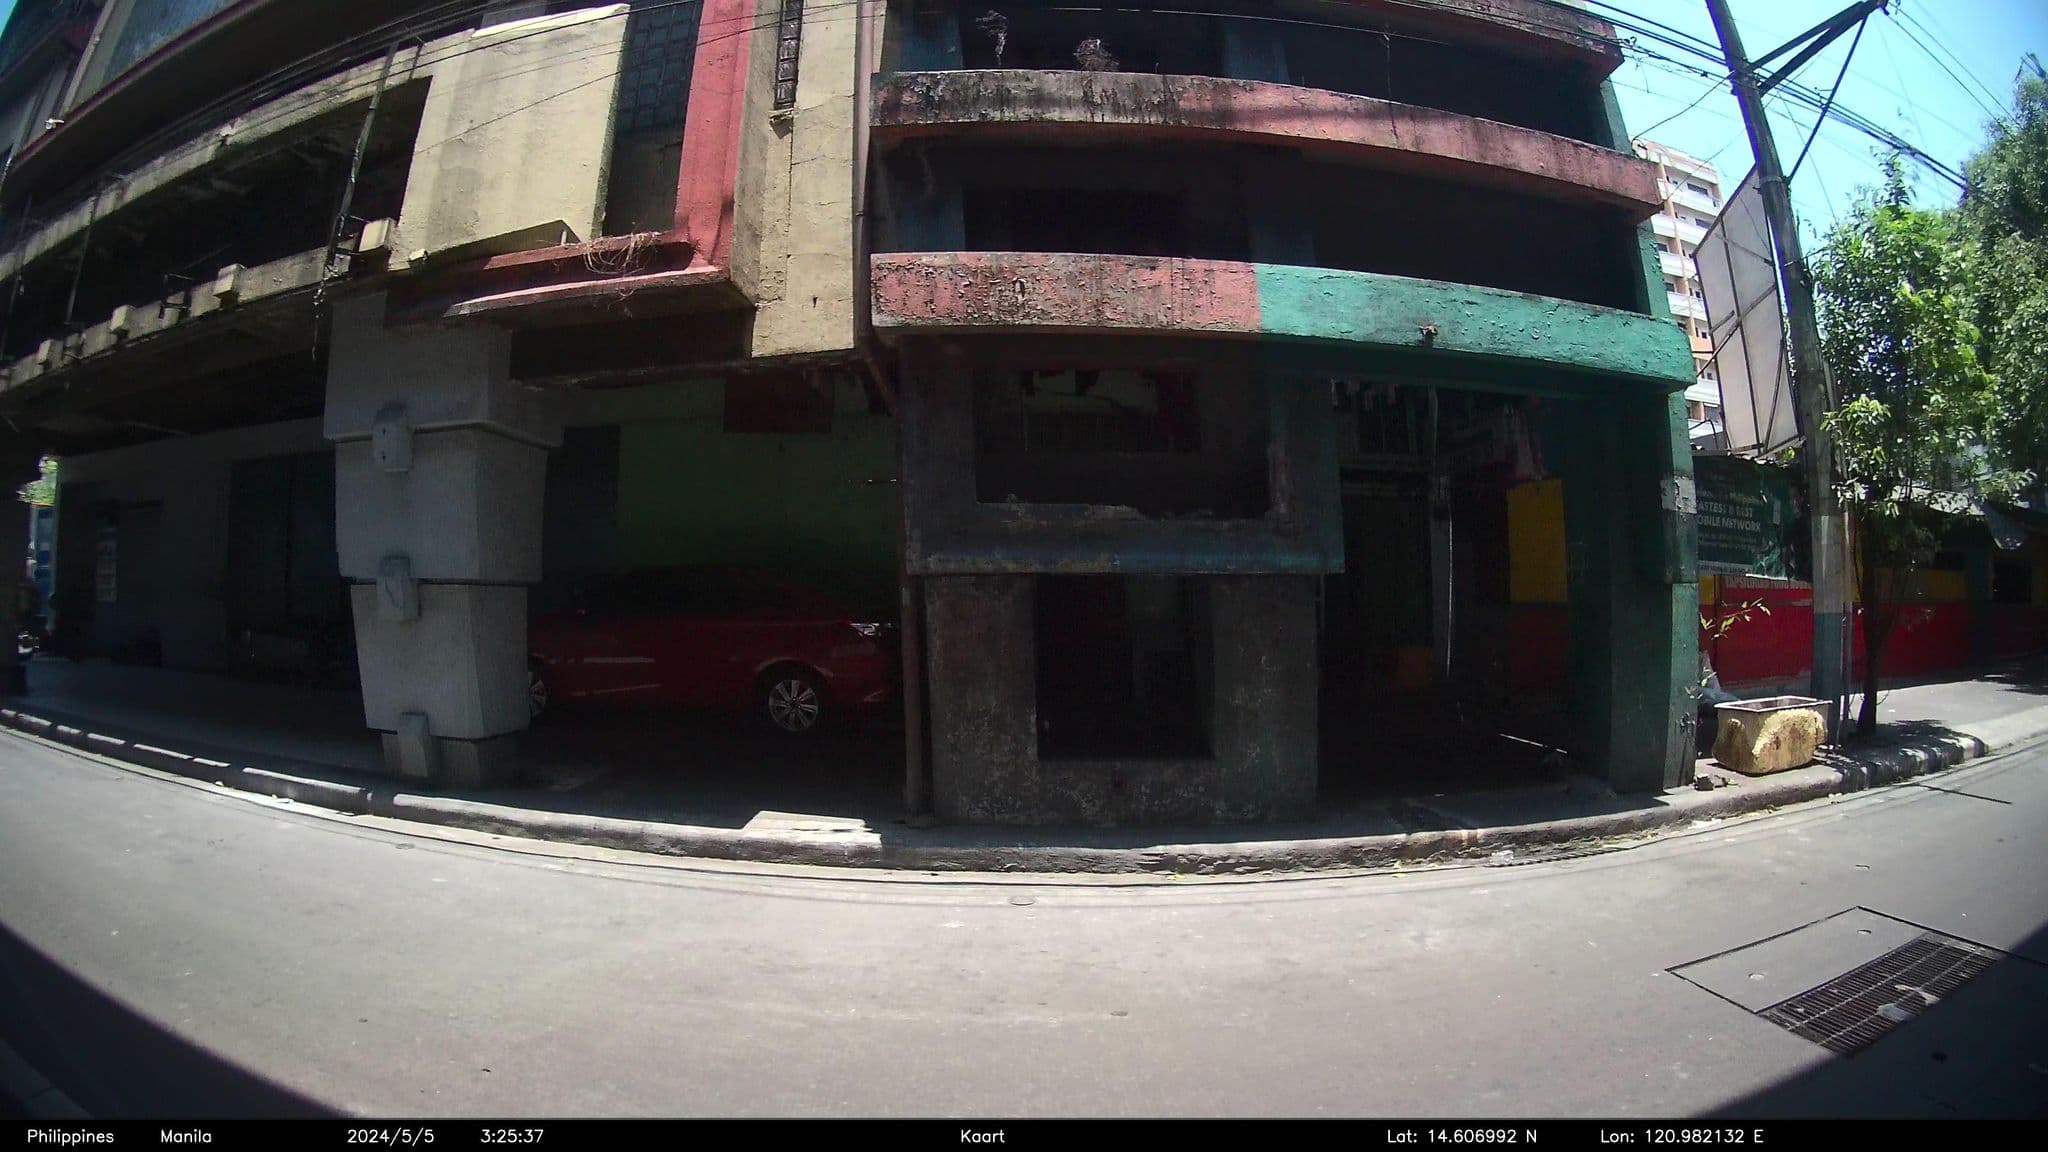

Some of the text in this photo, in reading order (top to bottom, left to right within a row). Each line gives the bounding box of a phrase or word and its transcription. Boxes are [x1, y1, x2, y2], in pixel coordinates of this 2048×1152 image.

[1697, 500, 1726, 514] ASTEST
[1697, 514, 1760, 531] OBILE NETWORK
